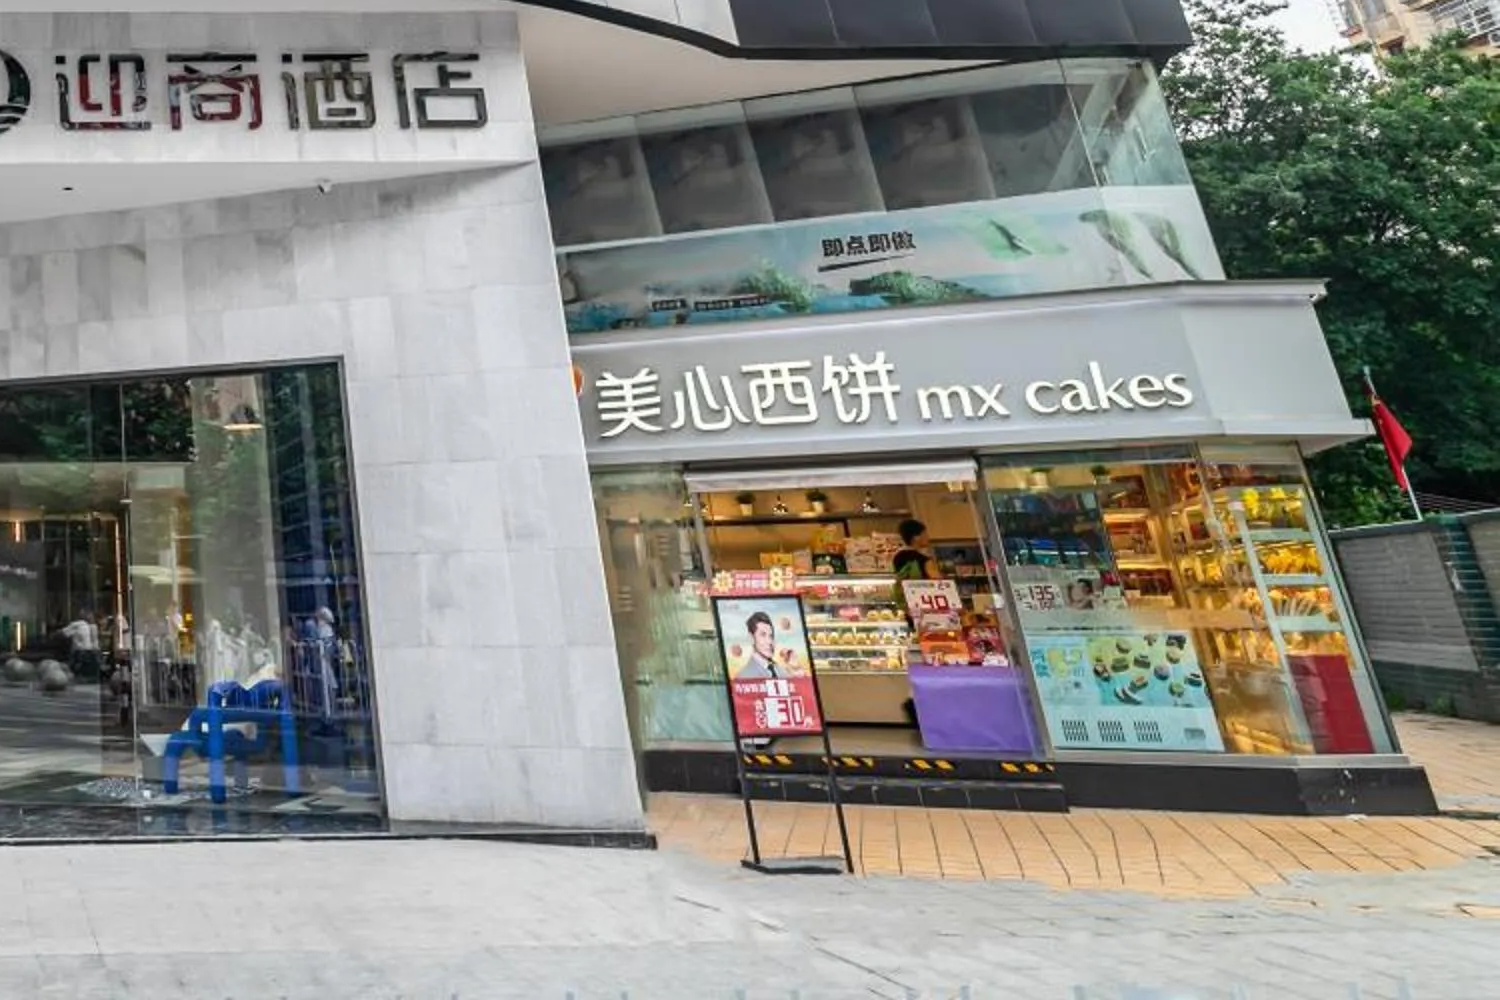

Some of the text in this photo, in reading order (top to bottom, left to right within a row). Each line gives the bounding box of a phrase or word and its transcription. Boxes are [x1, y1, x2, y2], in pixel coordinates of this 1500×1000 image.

[55, 51, 488, 131] 迎商酒店
[595, 350, 1193, 438] 美心西饼 mx cakes
[920, 594, 949, 610] 40
